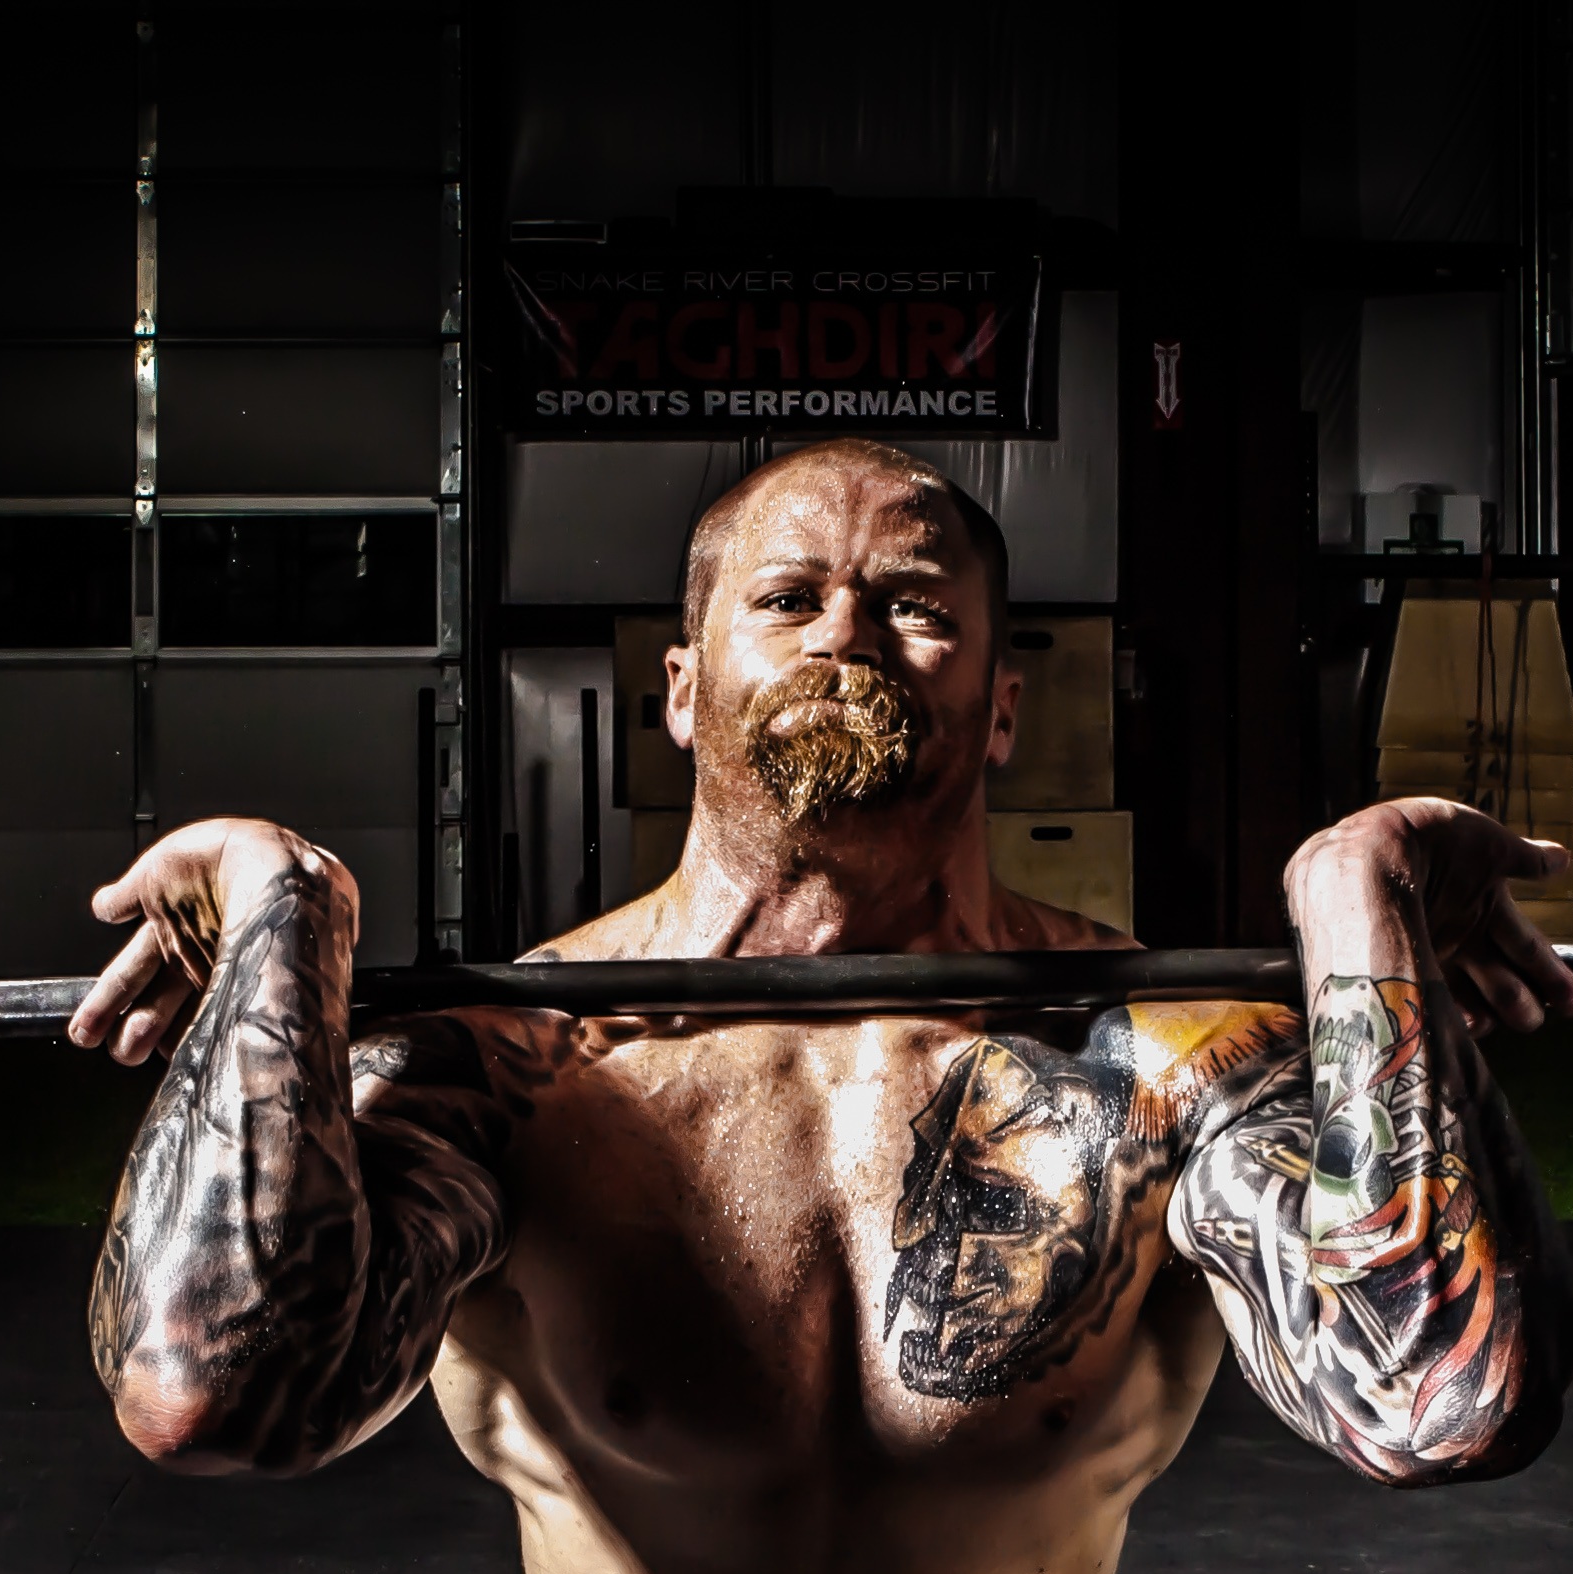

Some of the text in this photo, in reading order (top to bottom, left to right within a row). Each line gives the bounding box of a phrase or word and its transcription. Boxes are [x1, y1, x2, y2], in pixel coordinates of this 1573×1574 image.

[535, 270, 996, 292] SNAKE RIVER CROSSFIT
[548, 299, 997, 380] TAGHDIRI
[536, 389, 997, 417] SPORTS PERFORMANCE
